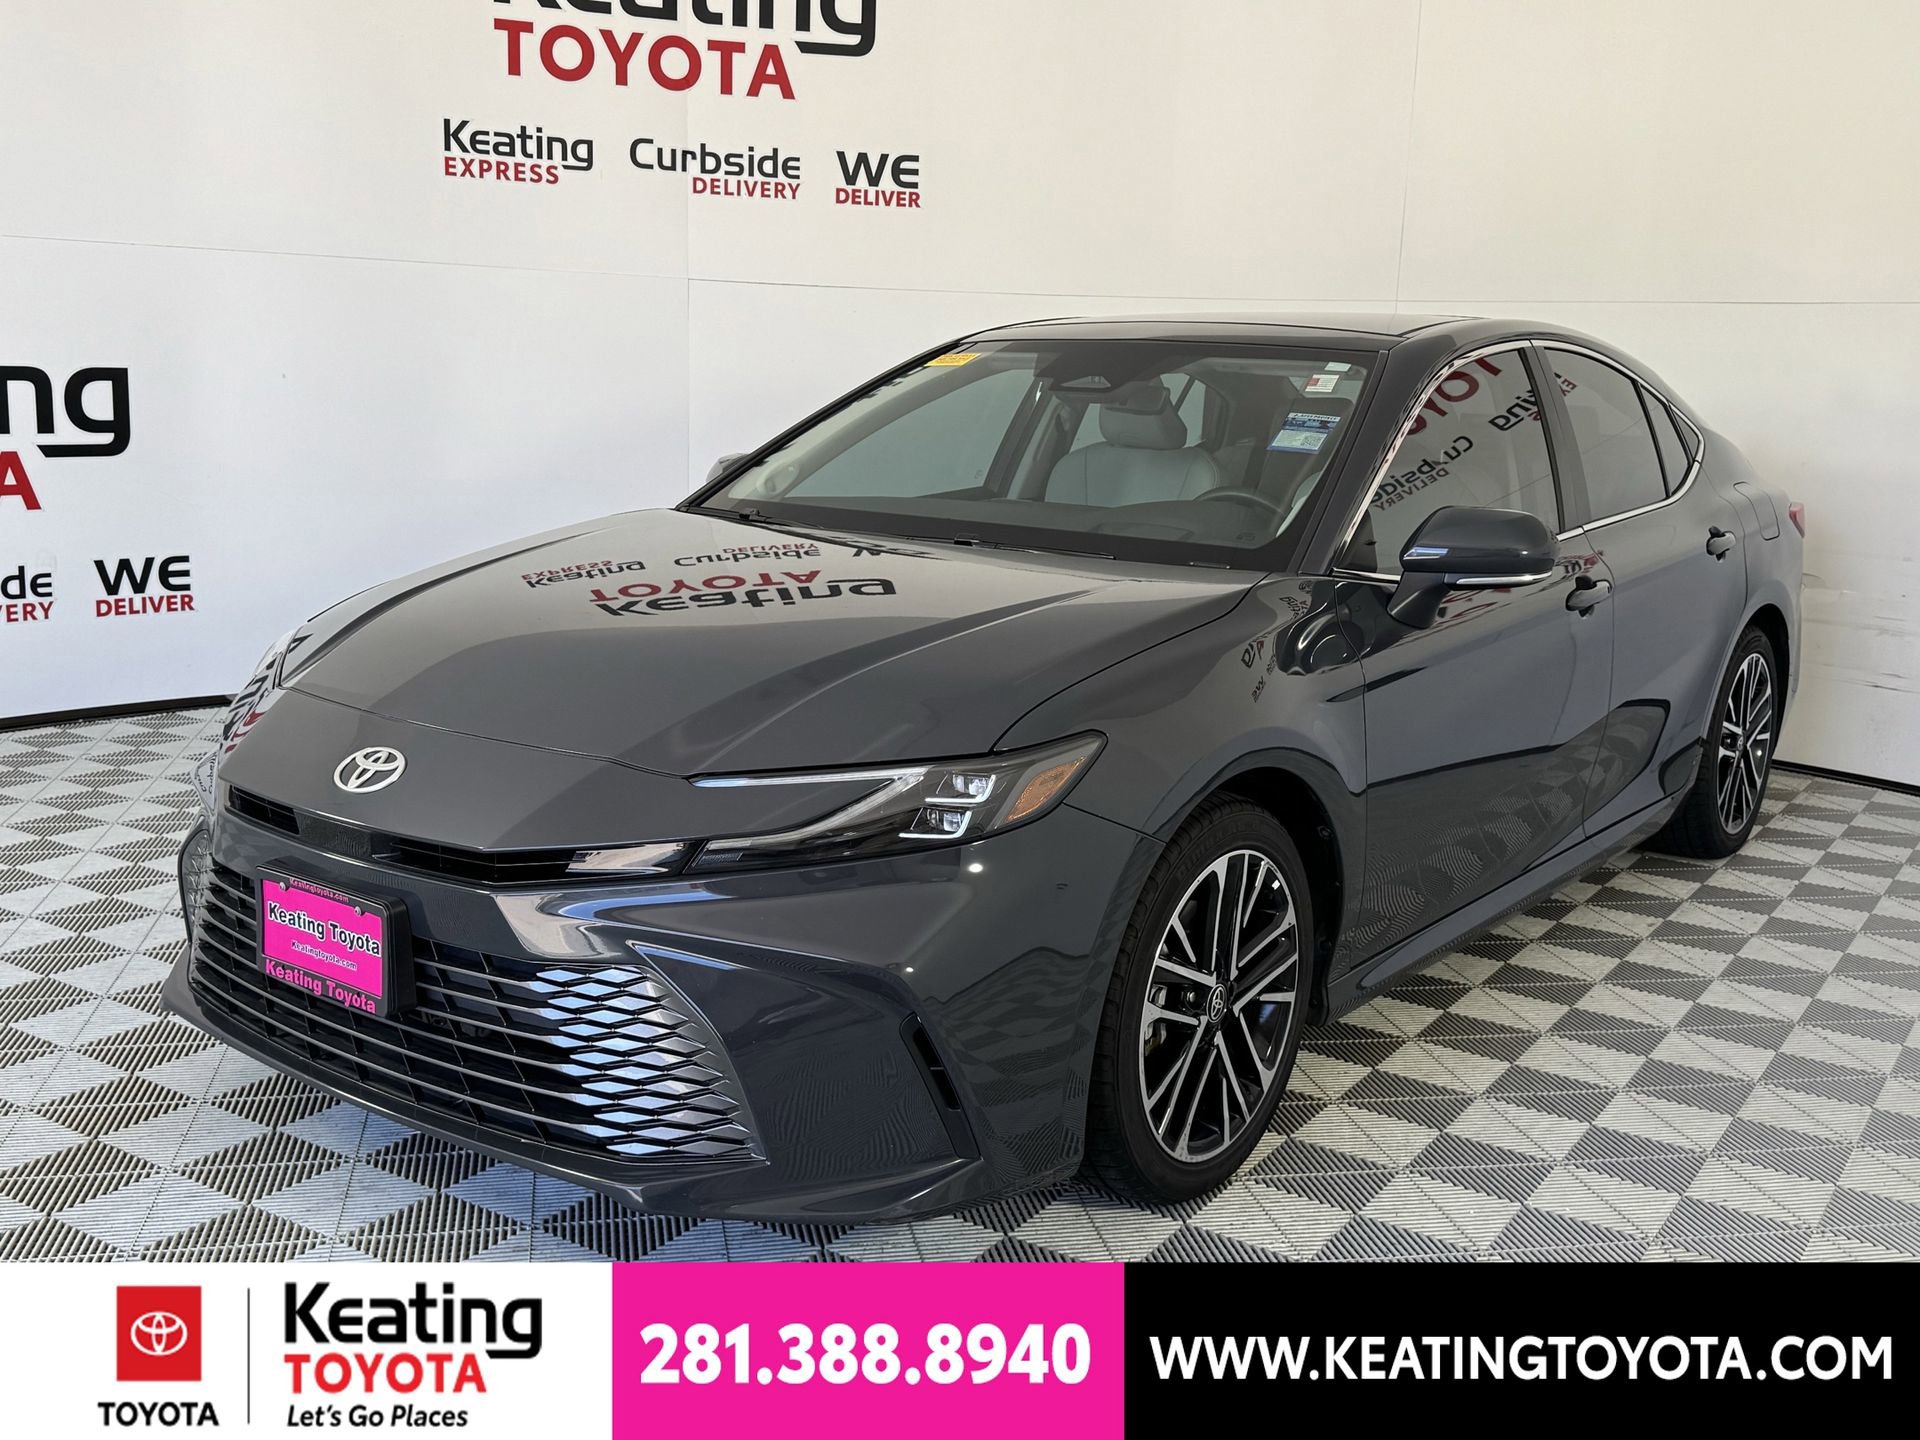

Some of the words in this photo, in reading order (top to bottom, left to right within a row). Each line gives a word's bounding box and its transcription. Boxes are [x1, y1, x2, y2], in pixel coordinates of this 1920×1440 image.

[493, 18, 795, 100] TOYOTA
[443, 118, 594, 171] Keating
[629, 137, 801, 180] Curbside
[443, 156, 560, 184] EXPRESS
[692, 177, 801, 200] DELIVERY
[836, 151, 920, 188] WE
[835, 188, 921, 208] DELIVER
[94, 555, 191, 595] WE
[95, 594, 194, 617] DELIVER
[267, 901, 325, 940] Keating
[329, 922, 381, 956] Toyota
[265, 959, 322, 996] Keating
[326, 981, 377, 1014] Toyota
